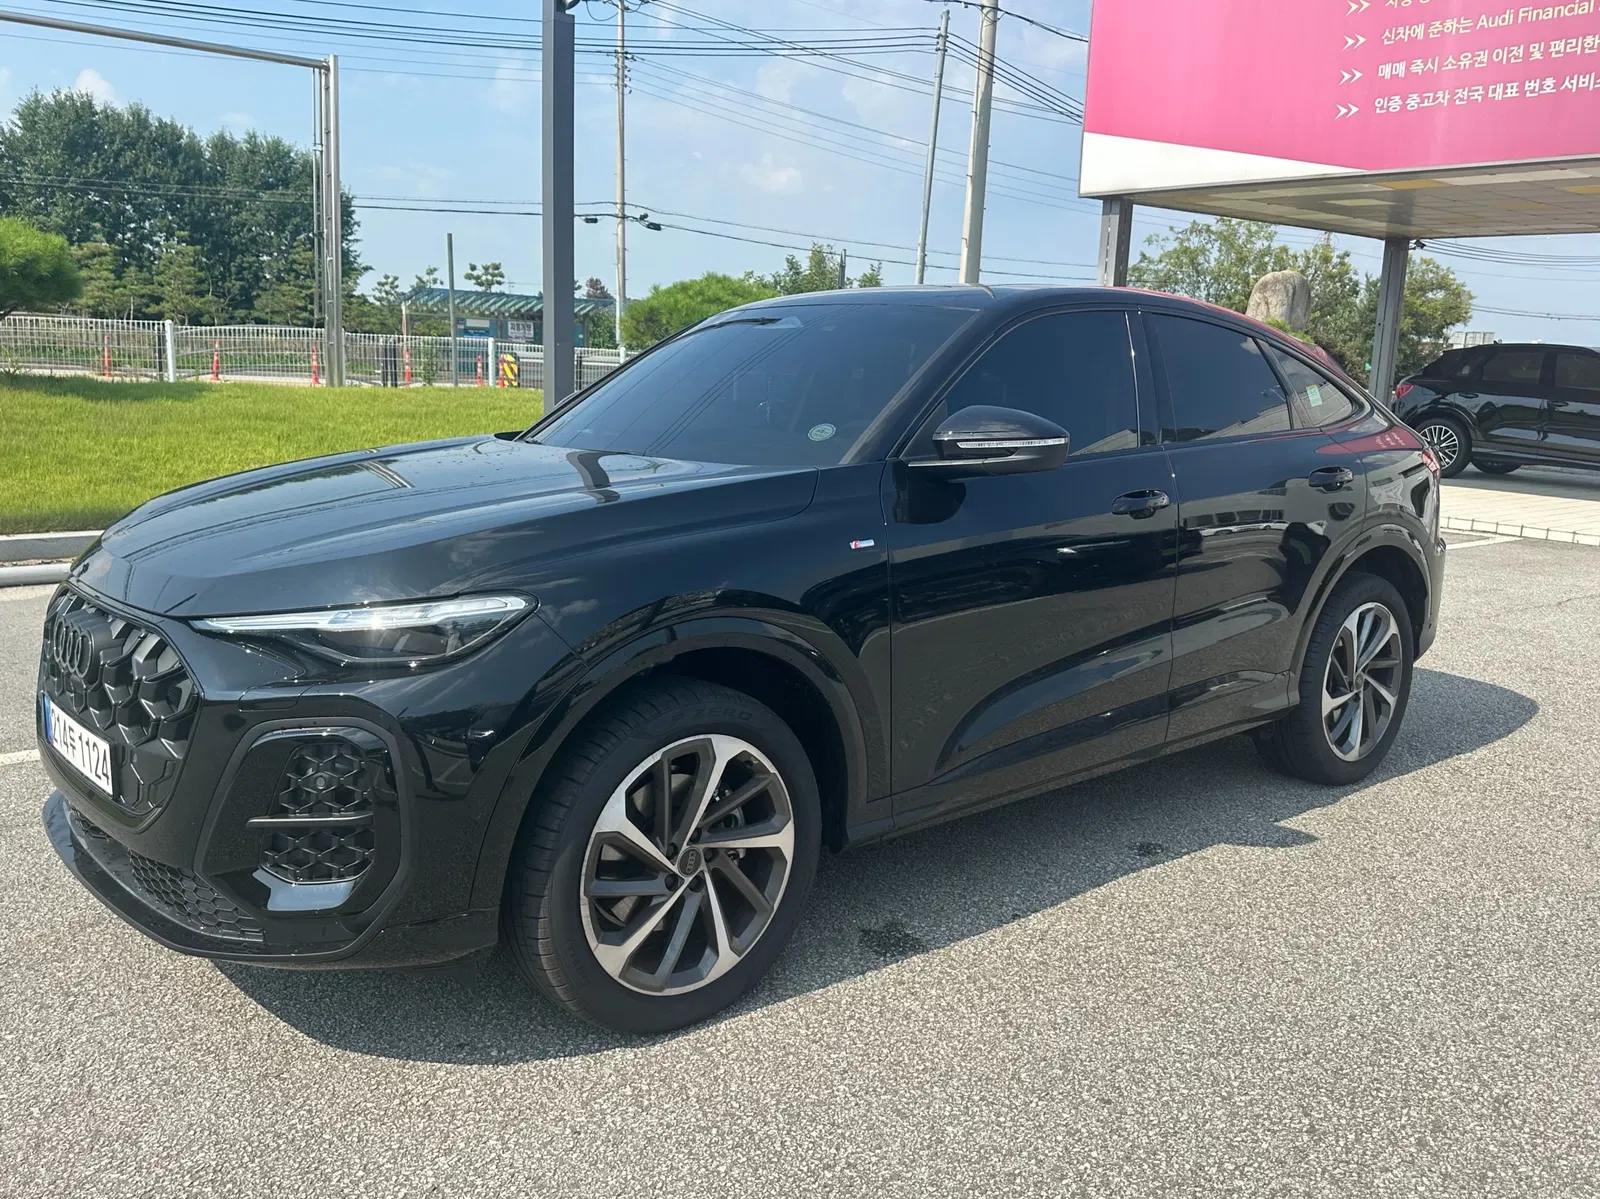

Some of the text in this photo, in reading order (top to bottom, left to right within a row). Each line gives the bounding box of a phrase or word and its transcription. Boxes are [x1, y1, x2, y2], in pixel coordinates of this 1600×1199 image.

[1381, 0, 1594, 45] 신차에 준하는 Audi Financial
[1377, 61, 1406, 79] 매매
[1409, 56, 1439, 75] 즉시
[1441, 49, 1489, 70] 소유권
[1492, 44, 1524, 65] 이전
[1529, 41, 1545, 61] 및
[1374, 95, 1403, 114] 인증
[1405, 89, 1451, 111] 중고차
[1453, 86, 1485, 105] 전국
[1487, 82, 1520, 100] 대표
[1524, 77, 1557, 98] 번호
